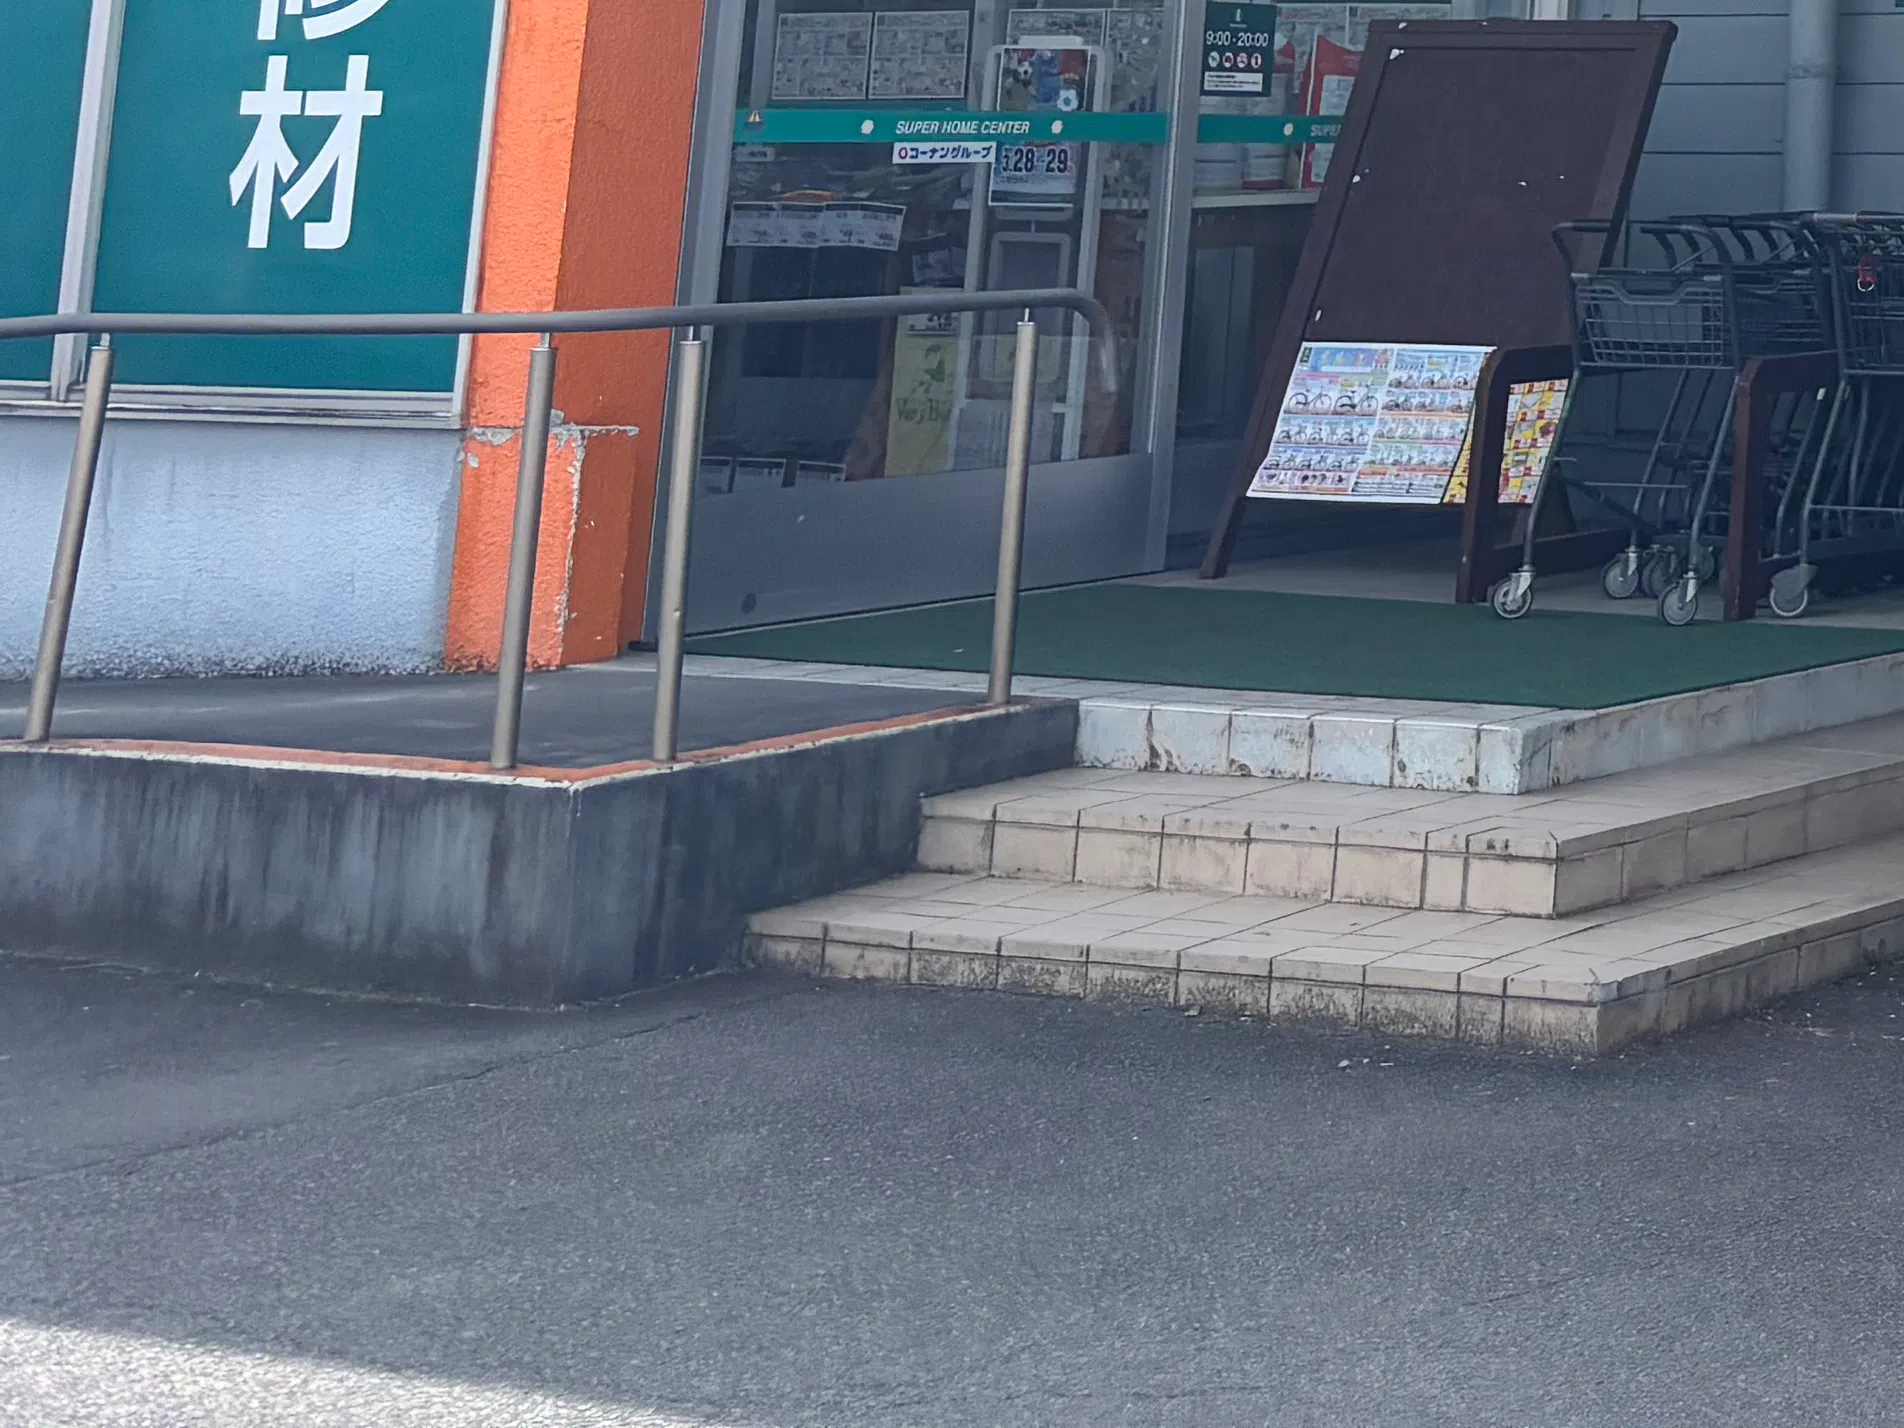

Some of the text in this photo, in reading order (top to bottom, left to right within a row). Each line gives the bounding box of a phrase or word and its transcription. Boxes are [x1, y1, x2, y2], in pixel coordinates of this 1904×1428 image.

[896, 121, 1030, 134] SUPER HOME CENTER
[909, 146, 992, 160] コーナングループ
